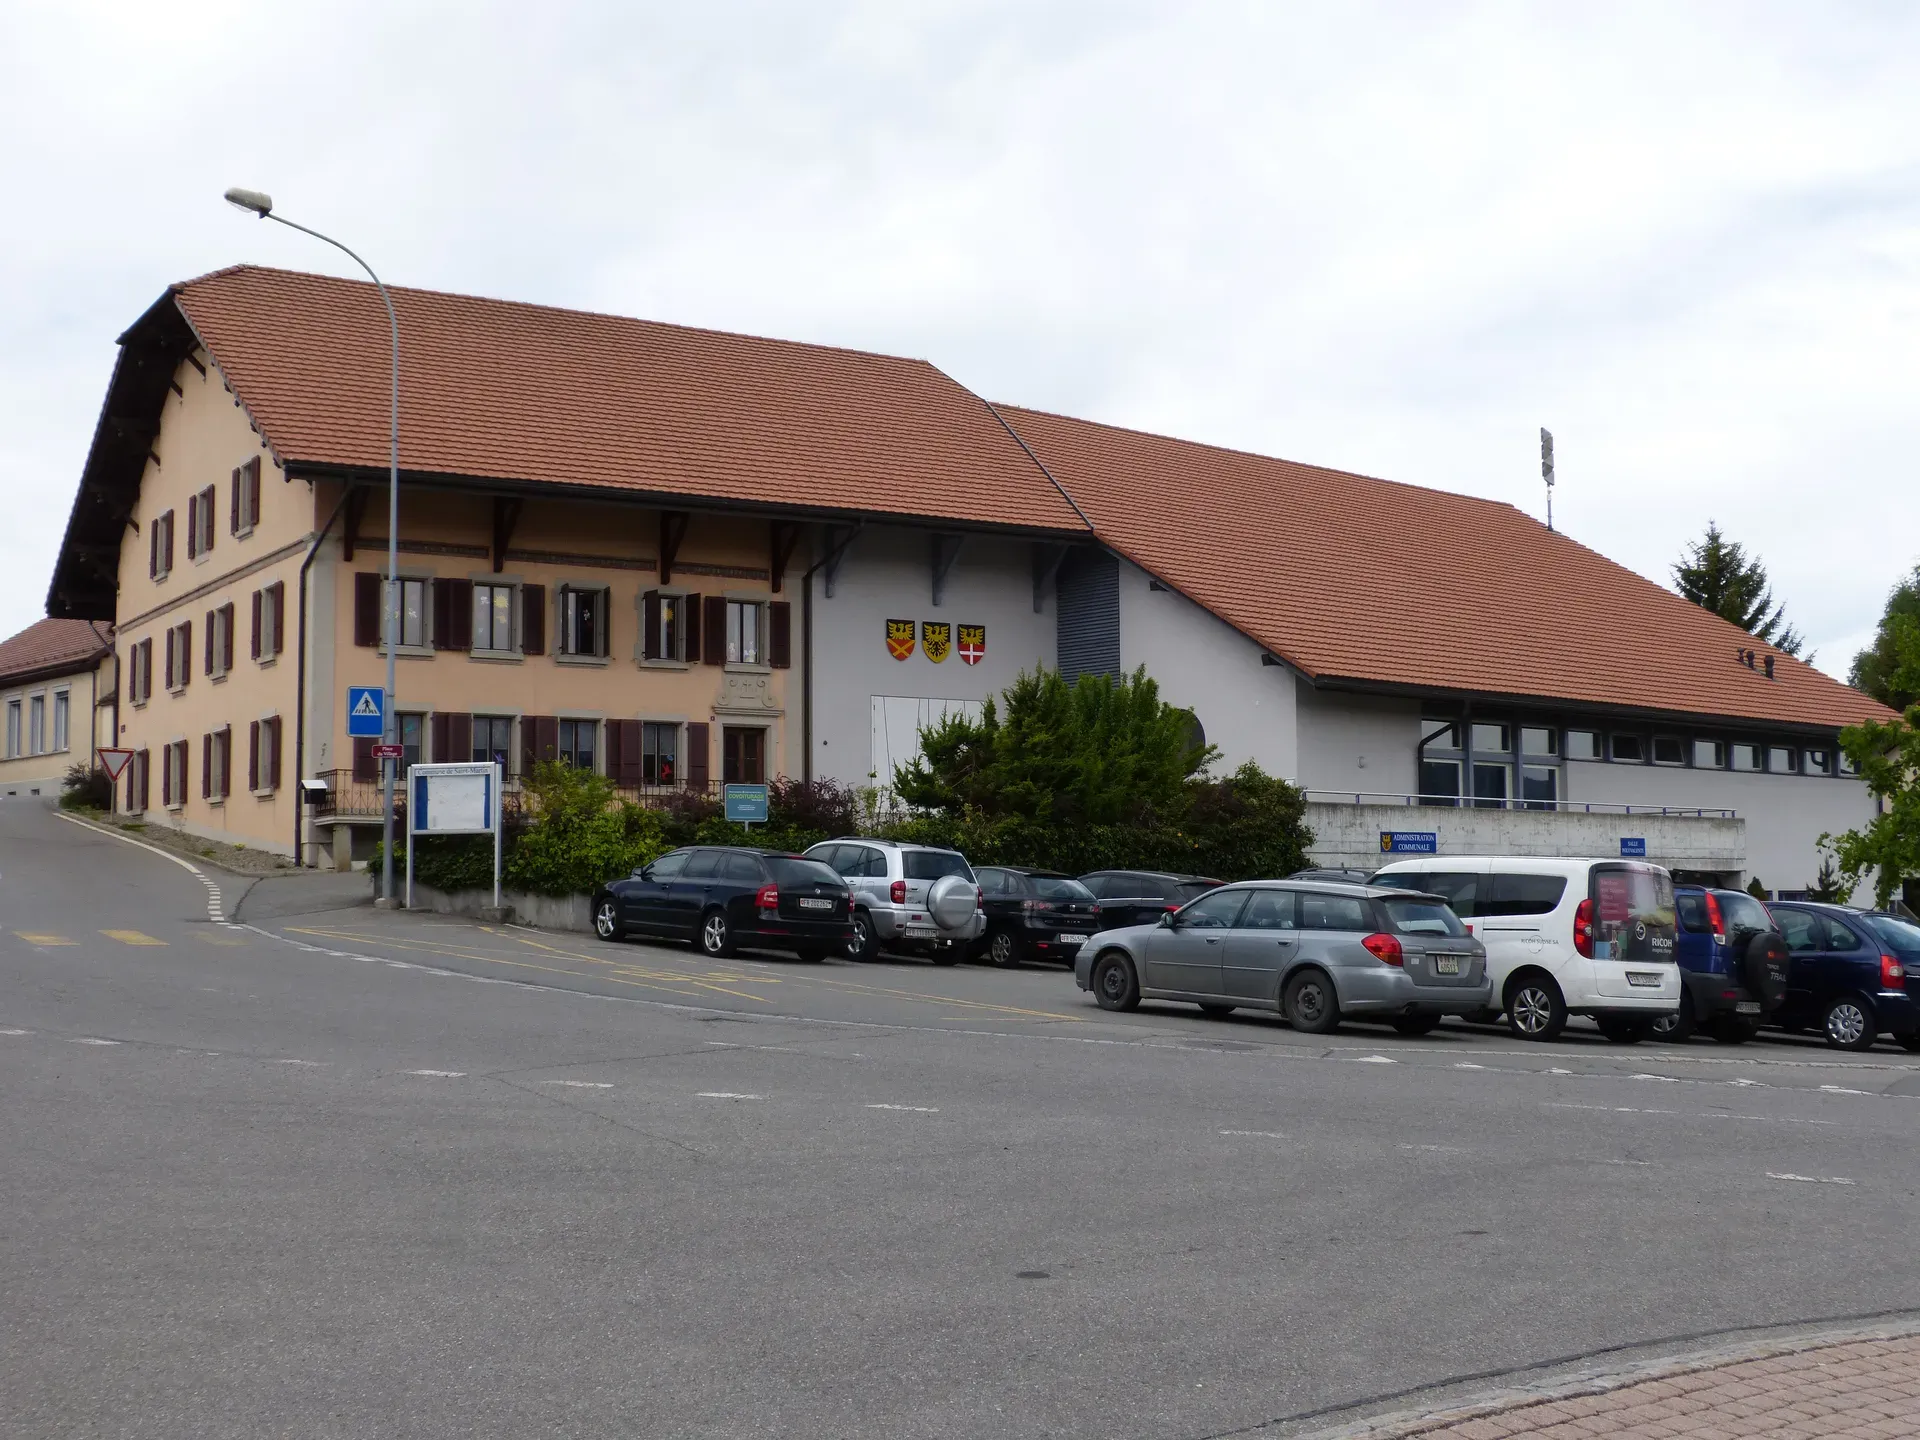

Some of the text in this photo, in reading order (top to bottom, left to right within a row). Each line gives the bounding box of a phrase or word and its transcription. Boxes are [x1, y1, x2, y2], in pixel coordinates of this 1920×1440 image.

[1393, 834, 1435, 842] ADMINISTRATION
[1398, 843, 1430, 851] COMMUNALE
[1651, 937, 1673, 947] RICOH
[1770, 971, 1787, 982] TRAIL
